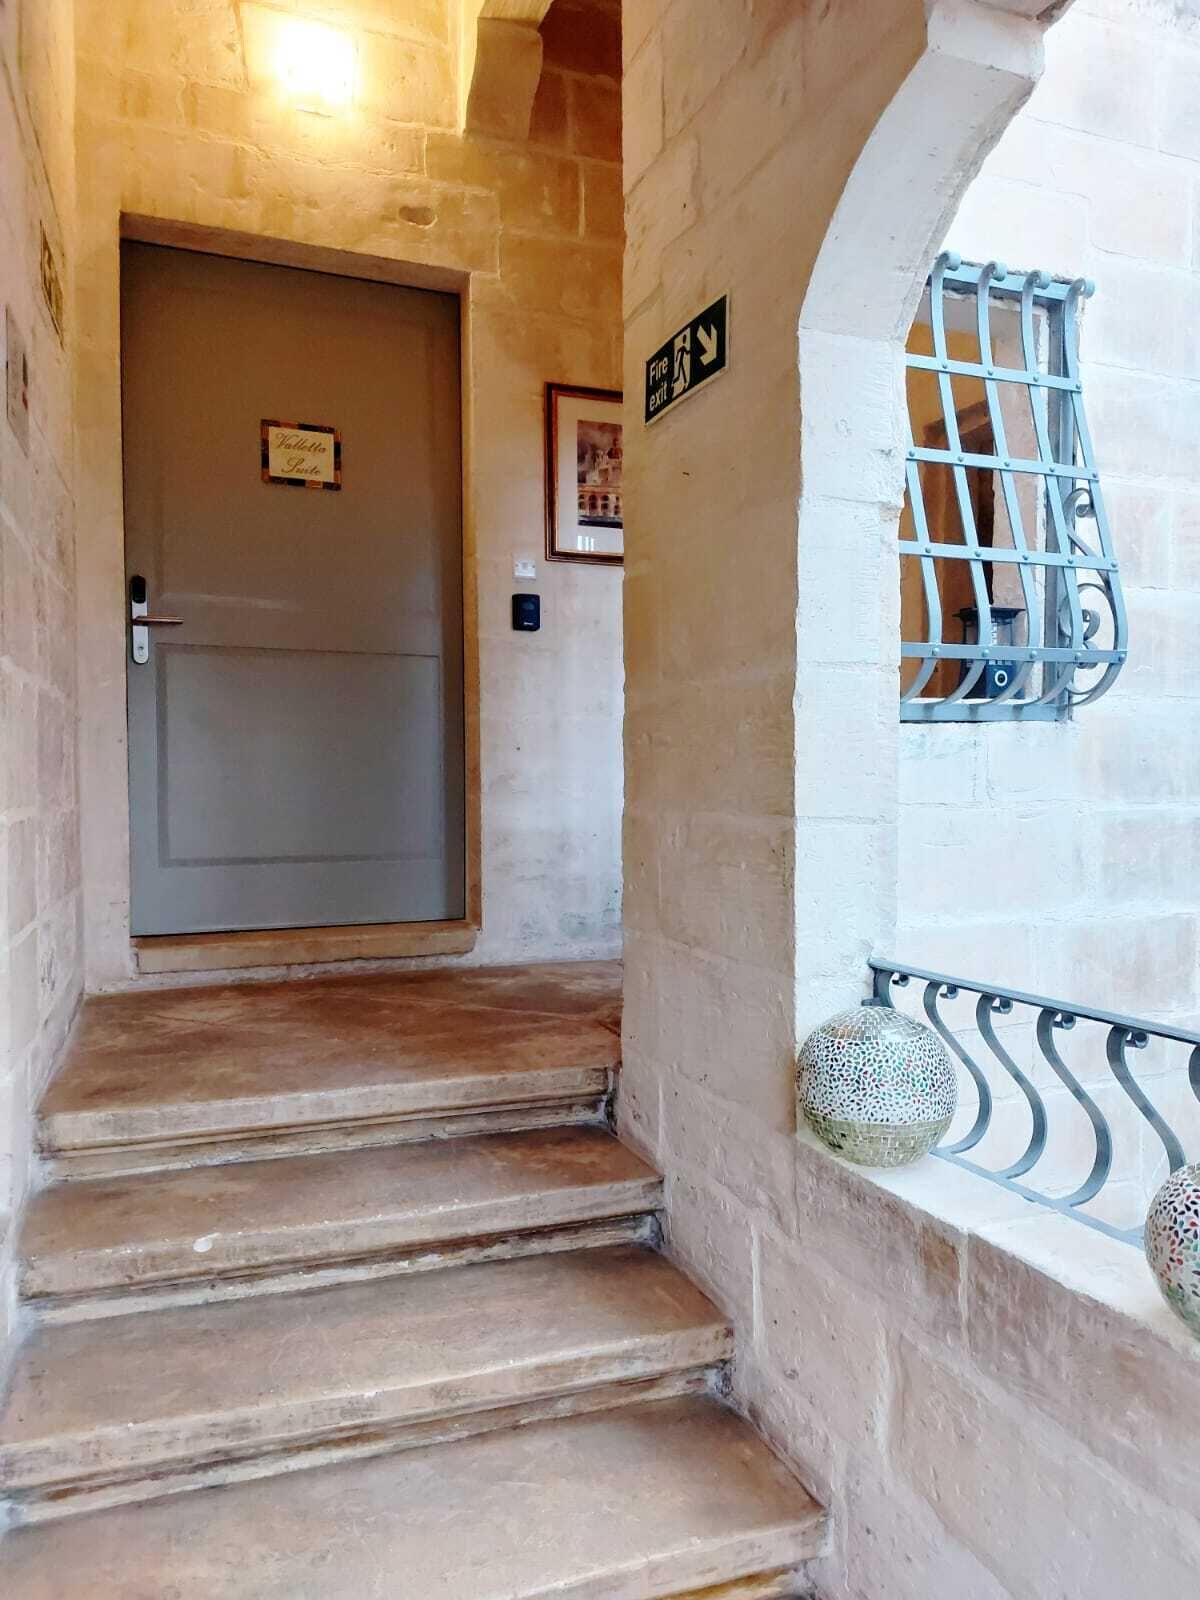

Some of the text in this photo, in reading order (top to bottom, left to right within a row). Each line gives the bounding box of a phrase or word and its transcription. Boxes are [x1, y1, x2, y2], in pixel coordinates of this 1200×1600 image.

[649, 357, 668, 386] Fire
[649, 381, 668, 412] exit
[275, 432, 326, 453] Valletta
